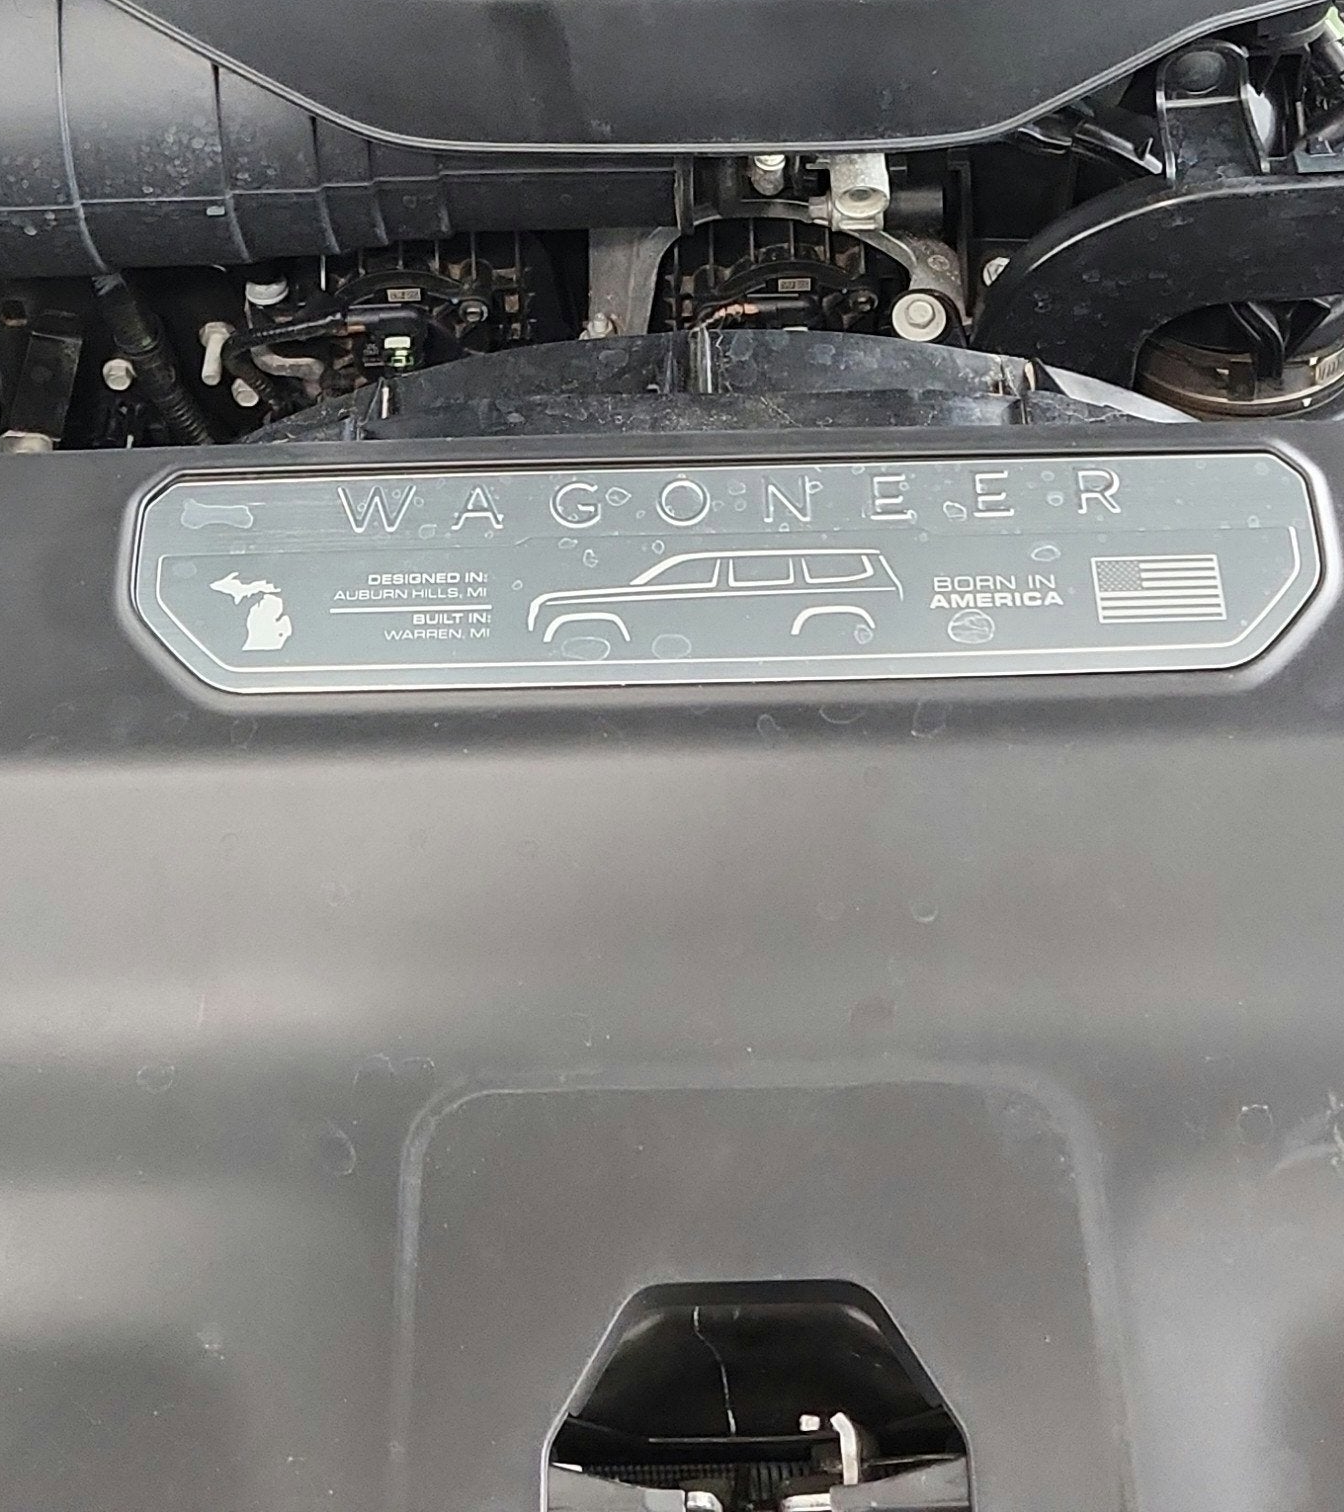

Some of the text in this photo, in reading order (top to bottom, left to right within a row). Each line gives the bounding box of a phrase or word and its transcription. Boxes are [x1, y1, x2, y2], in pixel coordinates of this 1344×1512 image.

[336, 467, 1123, 534] WAGONEER
[368, 571, 488, 586] DESIGNED IN:
[933, 574, 1057, 592] BORN IN
[333, 587, 487, 601] AUBURN HILLS, MI
[929, 591, 1065, 609] AMERICA
[412, 612, 492, 626] BUILT IN:
[384, 628, 490, 641] WARREN, MI
